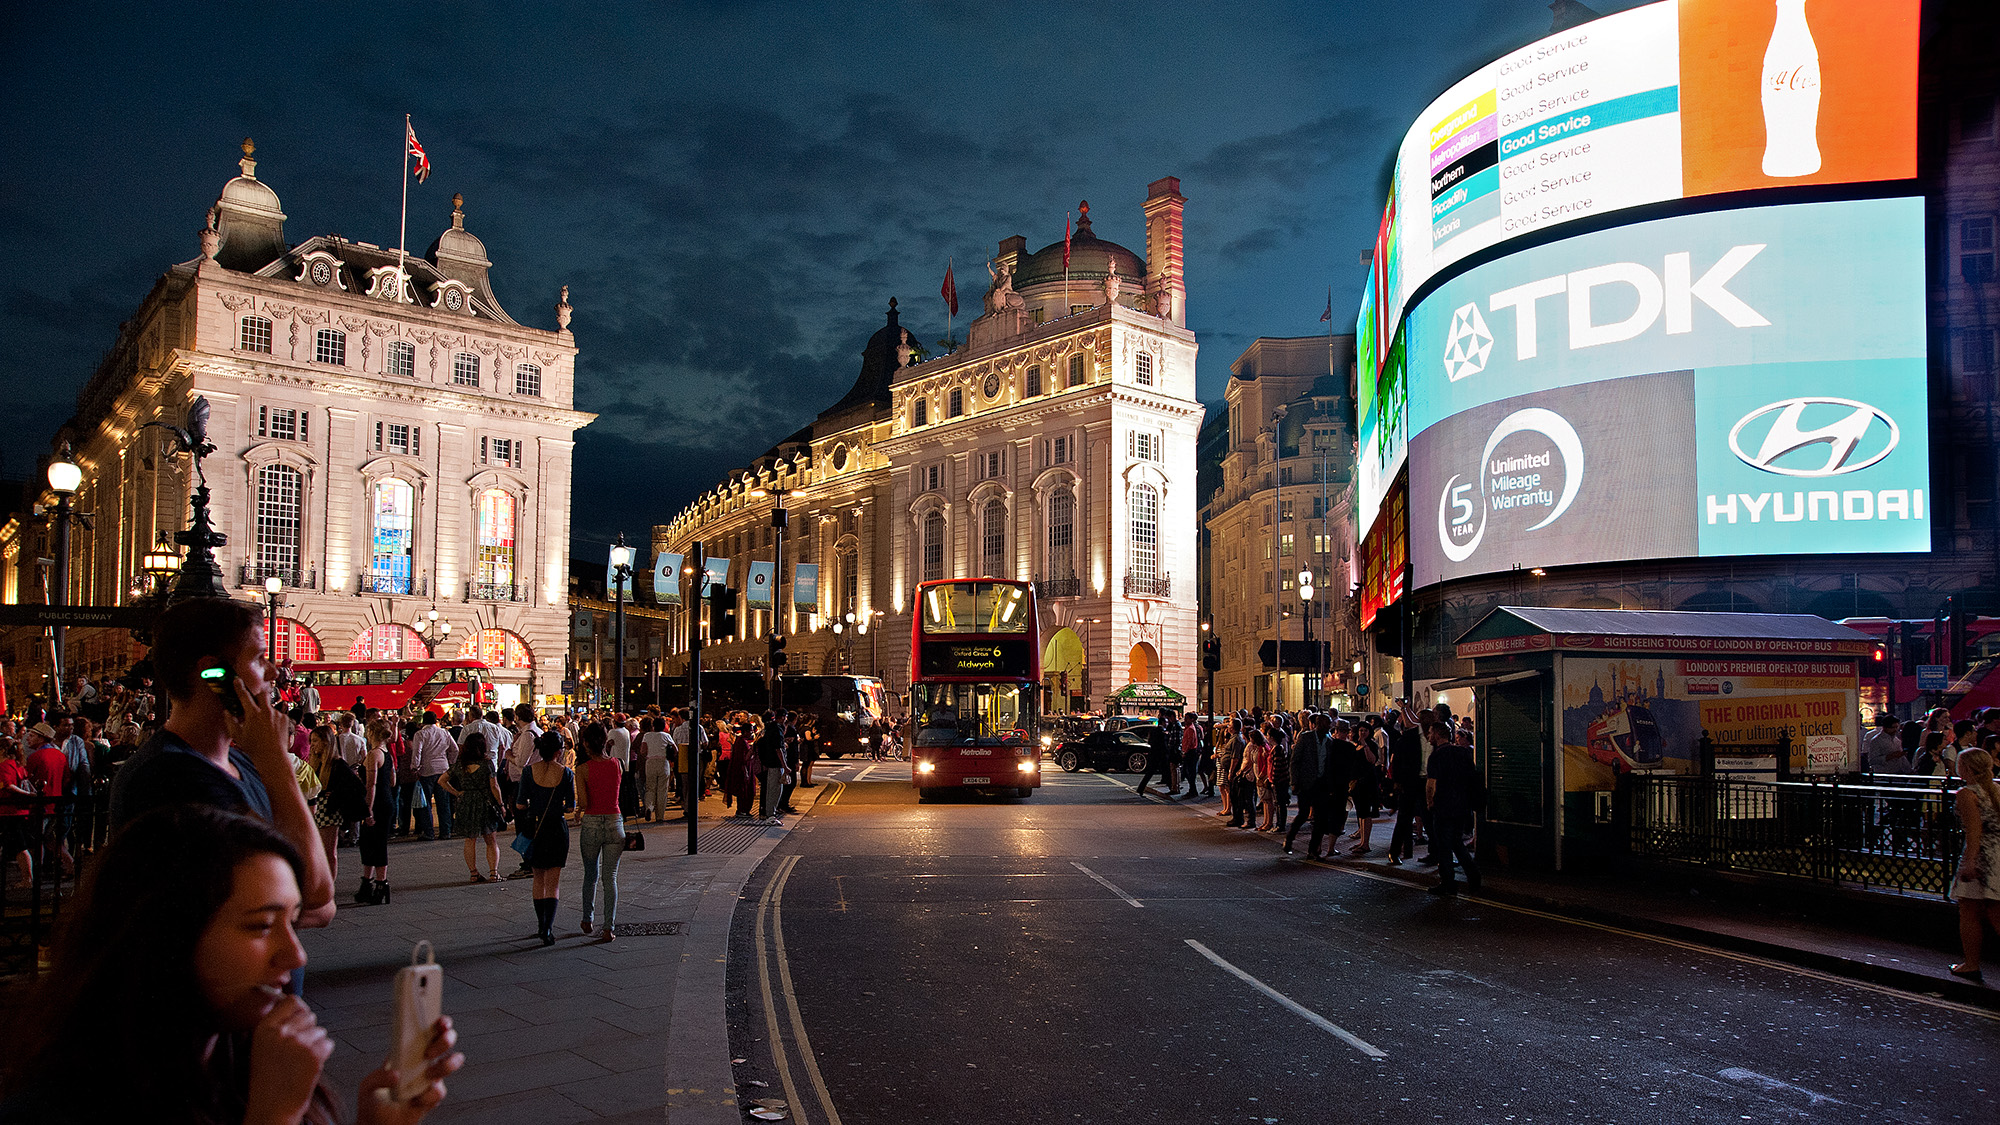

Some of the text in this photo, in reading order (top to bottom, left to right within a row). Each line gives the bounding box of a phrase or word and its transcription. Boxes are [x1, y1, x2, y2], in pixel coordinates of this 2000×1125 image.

[1499, 33, 1588, 77] Good Service
[1500, 60, 1589, 101] Good Service
[1501, 86, 1590, 127] Good Service
[1430, 104, 1477, 145] Overground
[1501, 113, 1591, 154] Good Service
[1431, 130, 1480, 171] Metropolitan
[1502, 142, 1591, 180] Good Service
[1431, 165, 1464, 194] Northern
[1503, 169, 1592, 206] Good Service
[1432, 187, 1468, 219] Piccadilly
[1504, 196, 1593, 232] Good Service
[1433, 217, 1460, 242] Victoria
[1490, 243, 1772, 361] TDK
[1491, 450, 1550, 476] Unlimited
[1491, 473, 1541, 494] Mileage
[1451, 483, 1473, 526] 5
[1491, 489, 1553, 511] Warranty
[1707, 488, 1924, 525] HYUNDAI
[1452, 523, 1474, 537] YEAR
[38, 611, 71, 620] PUBLIC
[993, 645, 1001, 657] 6
[1461, 641, 1484, 654] TICKETS
[1485, 640, 1494, 652] ON
[1495, 639, 1509, 651] SALE
[1510, 638, 1525, 650] HERE
[1603, 637, 1664, 649] SIGHTSEEING
[1666, 638, 1696, 649] TOURS
[1699, 639, 1711, 649] OF
[1713, 639, 1753, 650] LONDON
[1755, 640, 1767, 650] BY
[1769, 640, 1812, 651] OPEN-TOP
[1814, 641, 1832, 651] BUS
[957, 660, 994, 670] Aldwych
[1686, 662, 1850, 675] LONDON'S PREMIER OPEN-TOP BUS TOUR
[1705, 701, 1840, 724] THE ORIGINAL TOUR
[1715, 720, 1834, 744] your ultimate ticket
[960, 749, 992, 757] Metroline
